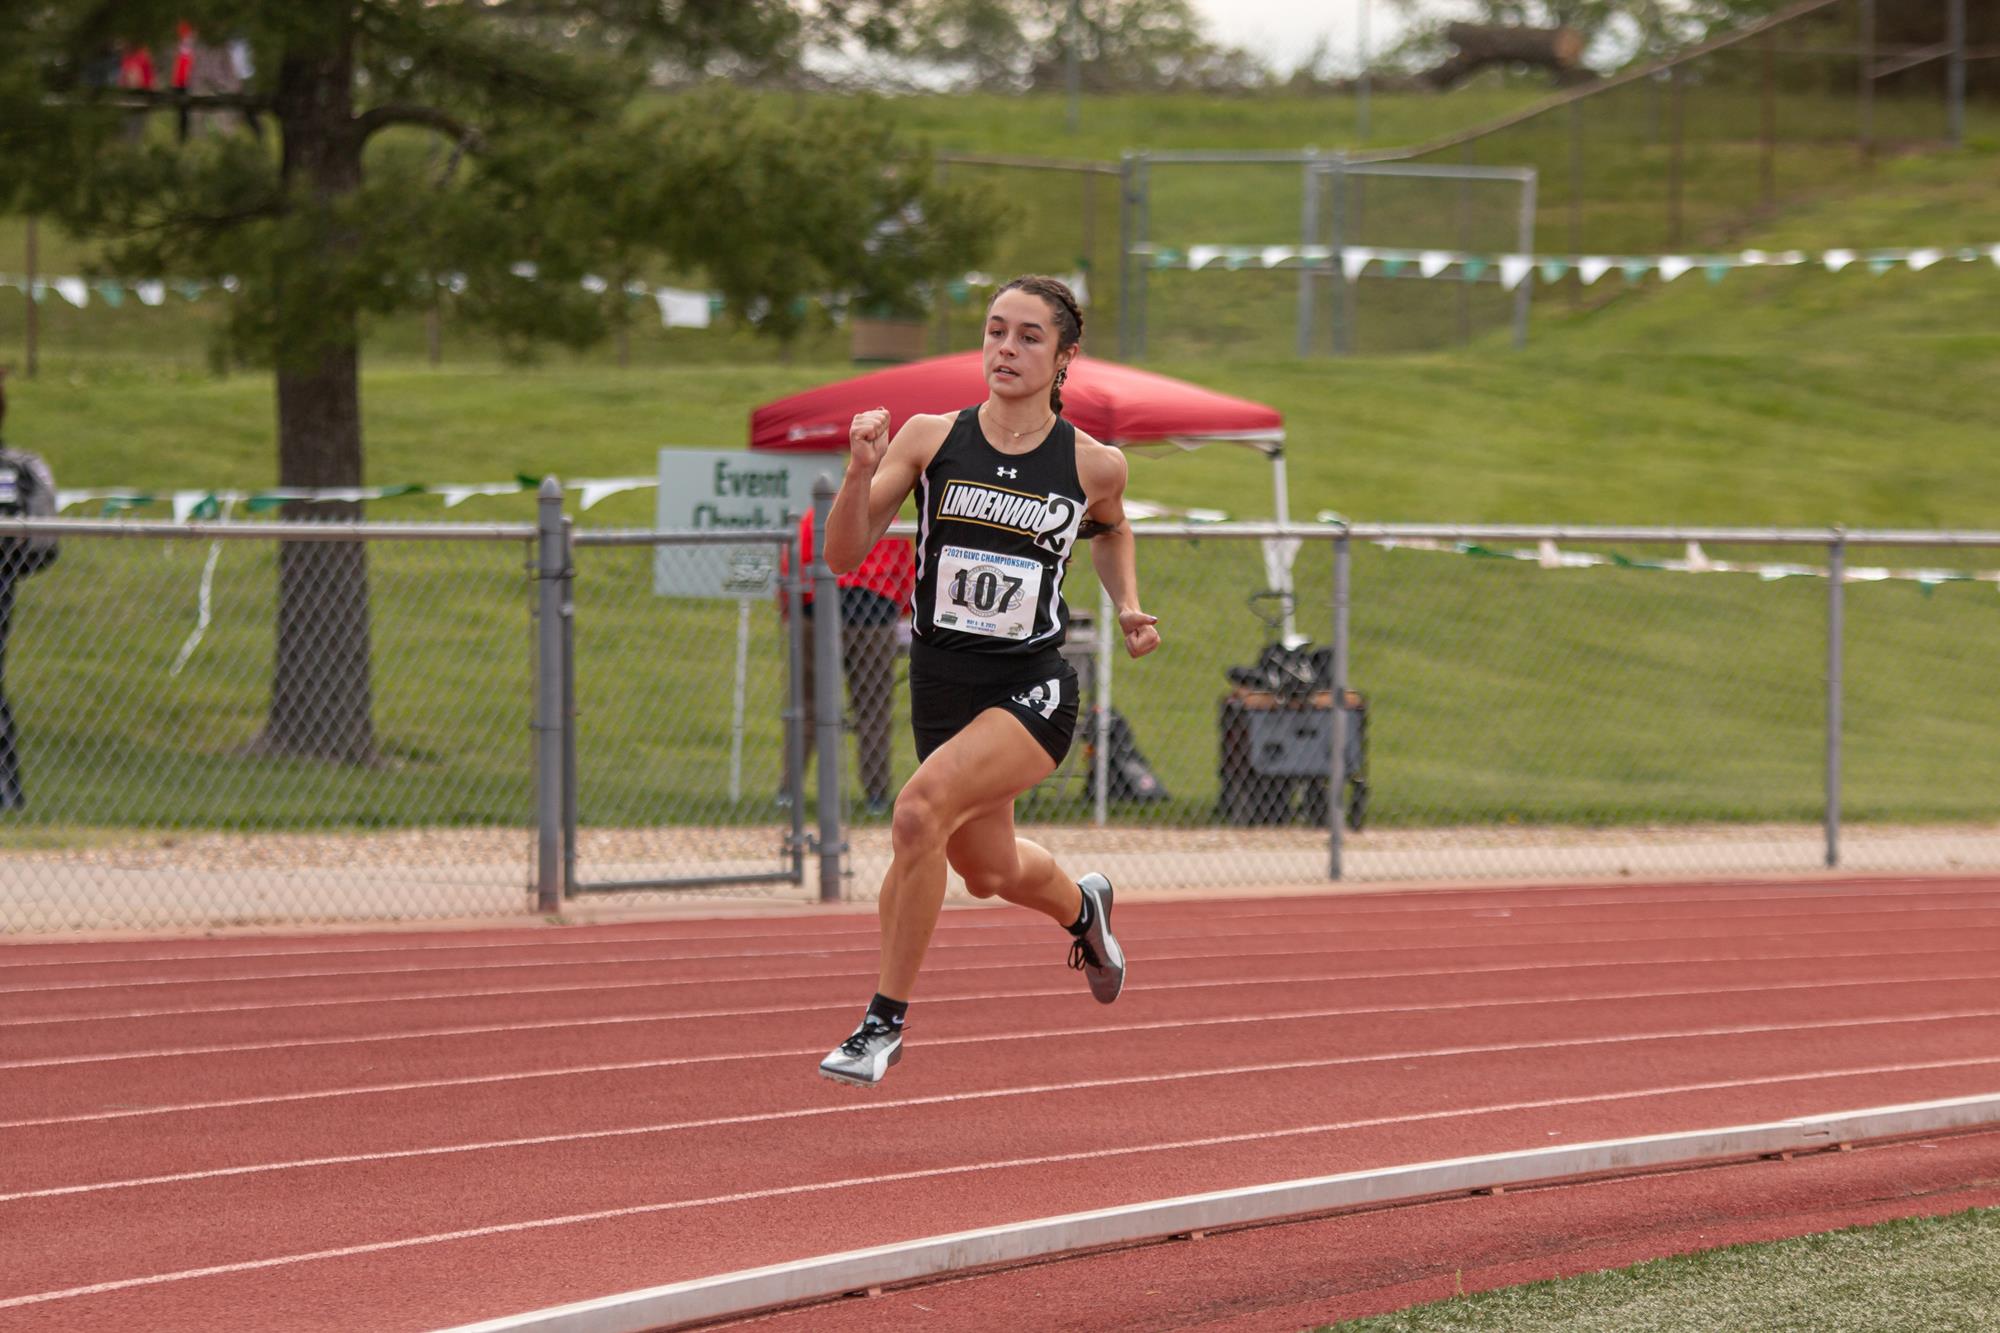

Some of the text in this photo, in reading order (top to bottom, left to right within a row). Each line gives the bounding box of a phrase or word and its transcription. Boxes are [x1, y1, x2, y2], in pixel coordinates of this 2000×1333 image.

[714, 459, 788, 498] Event
[941, 484, 1049, 533] LINDENWOO
[1036, 497, 1075, 553] 2
[947, 548, 1036, 570] 2021 GLVC CHAMPIONSHIPS
[952, 568, 1023, 614] 107
